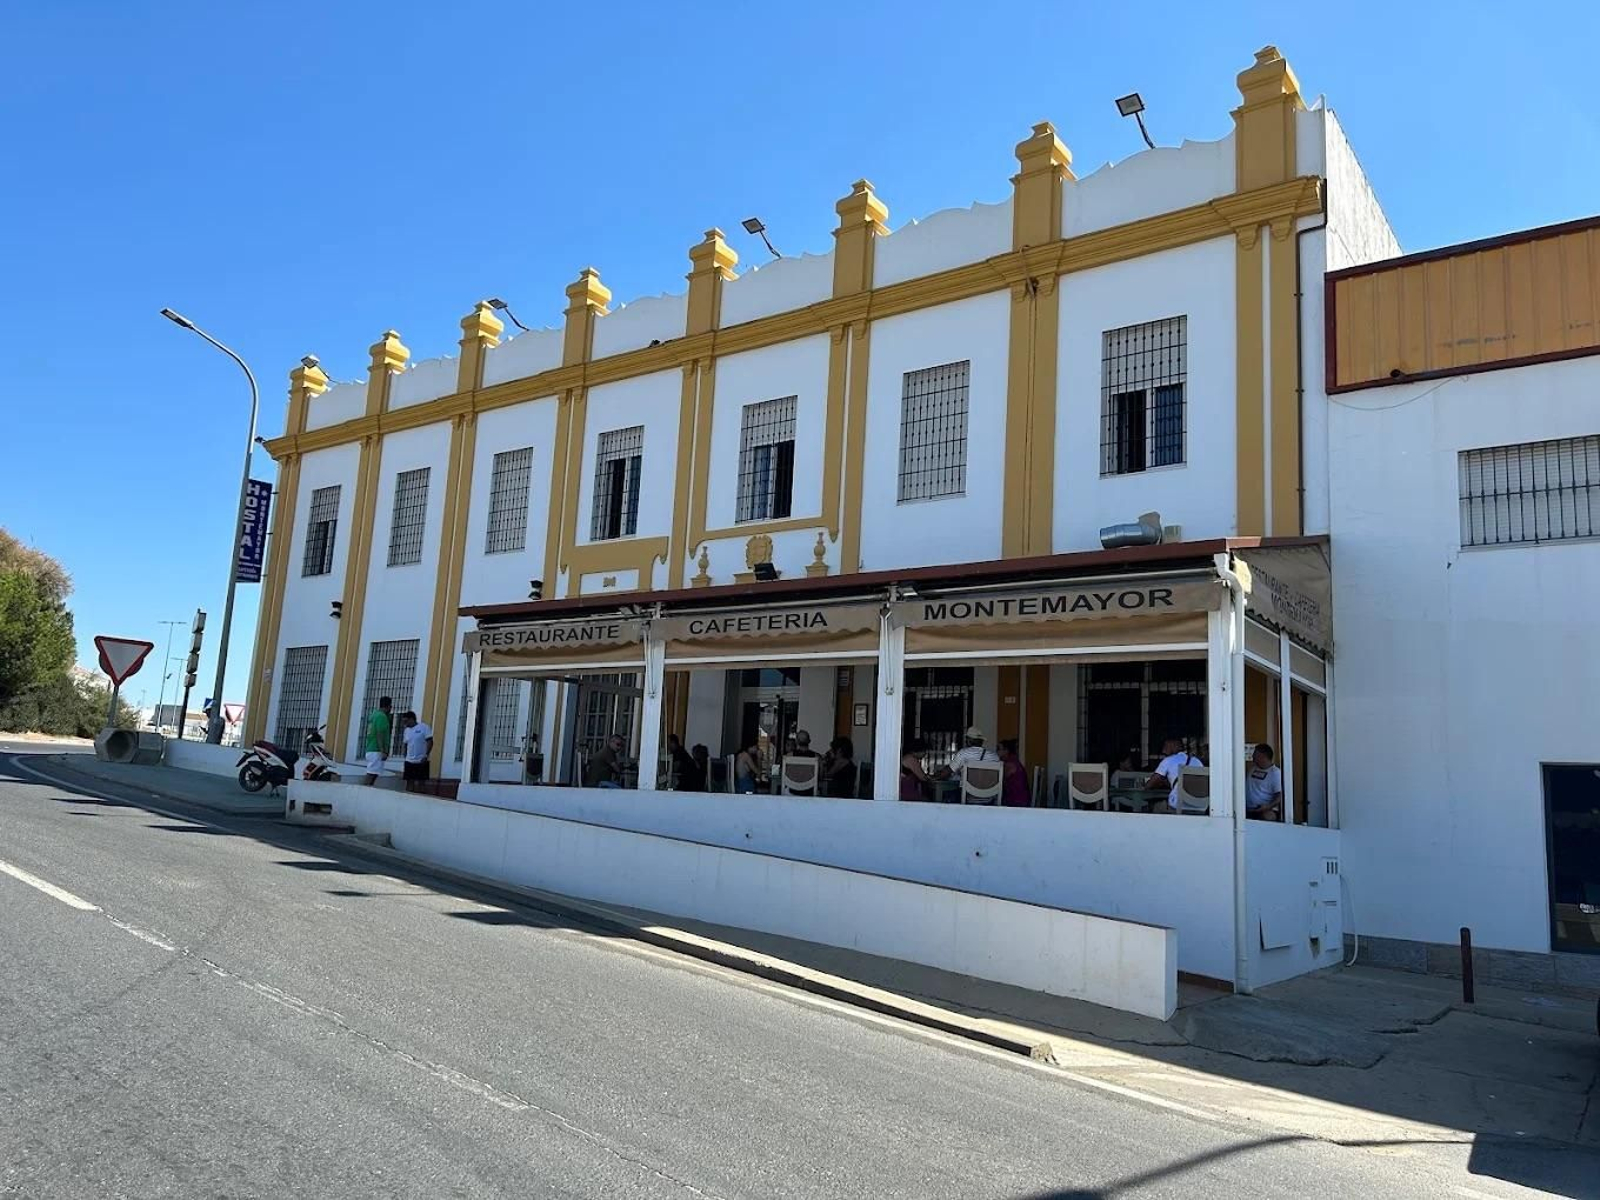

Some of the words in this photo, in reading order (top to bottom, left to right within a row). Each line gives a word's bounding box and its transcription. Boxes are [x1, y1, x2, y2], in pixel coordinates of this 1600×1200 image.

[239, 482, 261, 560] HOSTAL
[923, 588, 1174, 621] MONTEMAYOR
[479, 625, 620, 647] RESTAURANTE
[689, 611, 828, 635] CAFETERIA
